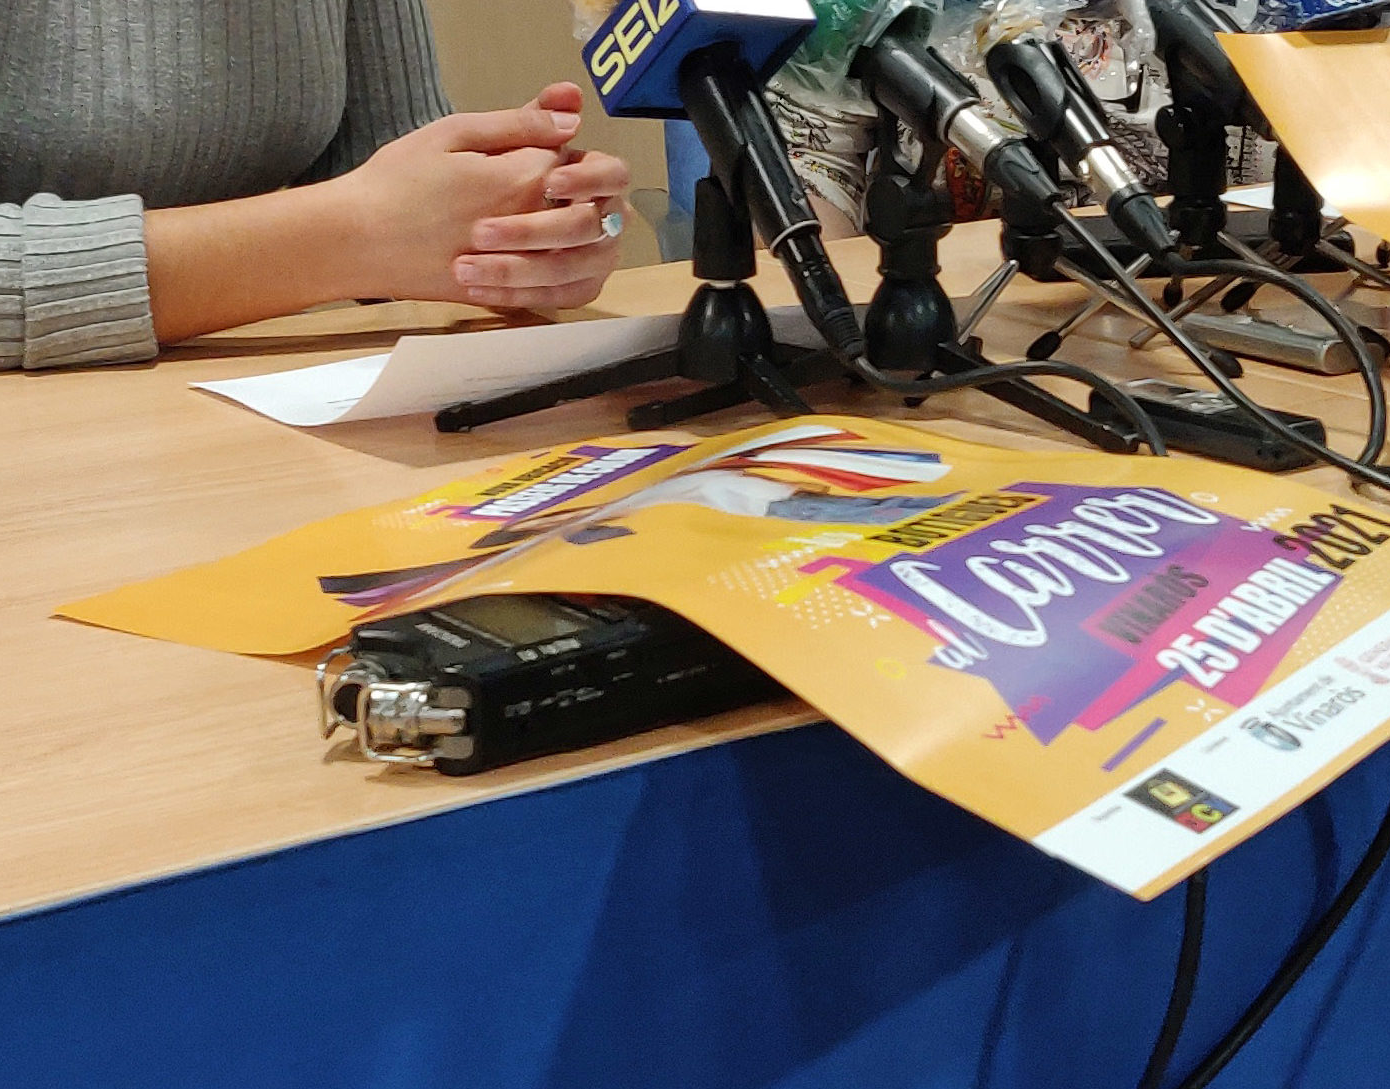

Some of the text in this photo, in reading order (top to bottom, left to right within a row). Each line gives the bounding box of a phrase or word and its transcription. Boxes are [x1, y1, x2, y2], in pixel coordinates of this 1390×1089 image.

[889, 488, 1220, 647] Carrer
[1192, 557, 1337, 654] D'ABRIL
[1156, 633, 1239, 689] 25
